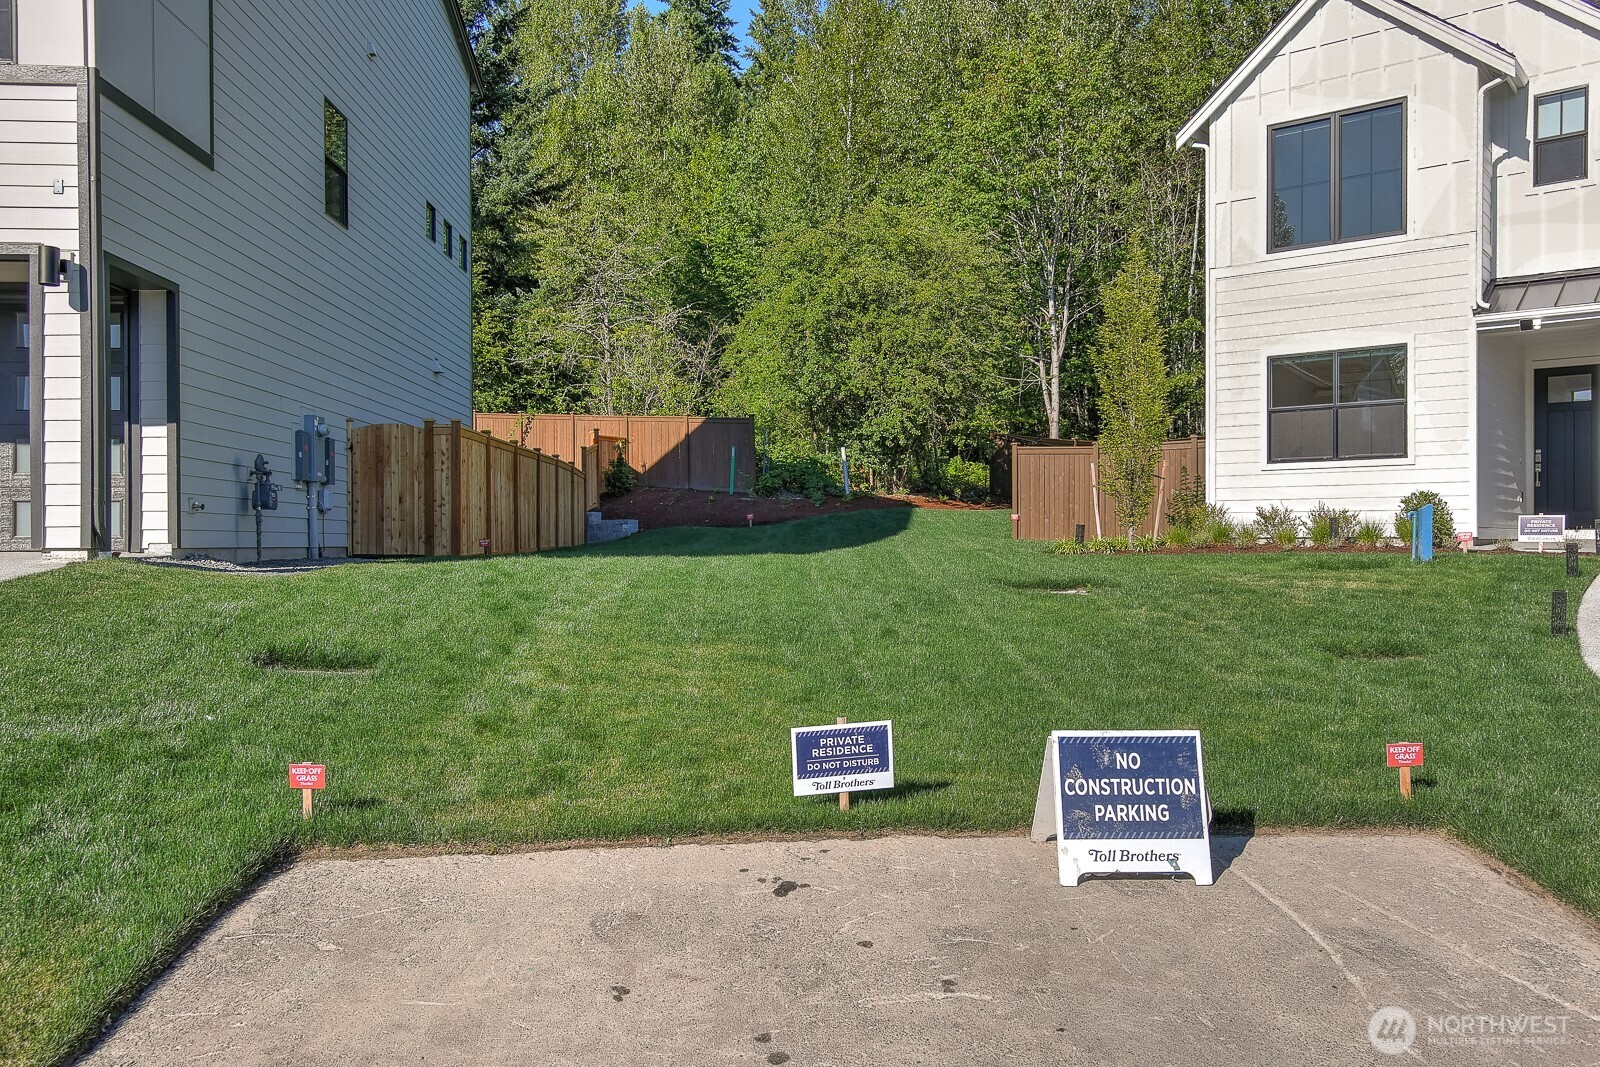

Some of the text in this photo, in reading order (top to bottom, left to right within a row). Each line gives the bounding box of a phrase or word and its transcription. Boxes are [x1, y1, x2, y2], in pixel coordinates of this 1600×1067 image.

[820, 735, 865, 747] PRIVATE
[812, 744, 874, 758] RESIDENCE
[1389, 746, 1406, 754] KEEP
[807, 758, 880, 771] DO NOT DISTURB
[1115, 752, 1141, 770] NO
[812, 778, 875, 791] Toll Brothers
[1064, 777, 1197, 796] CONSTRUCTION
[1094, 804, 1170, 822] PARKING
[1088, 849, 1180, 862] Toll Brothers
